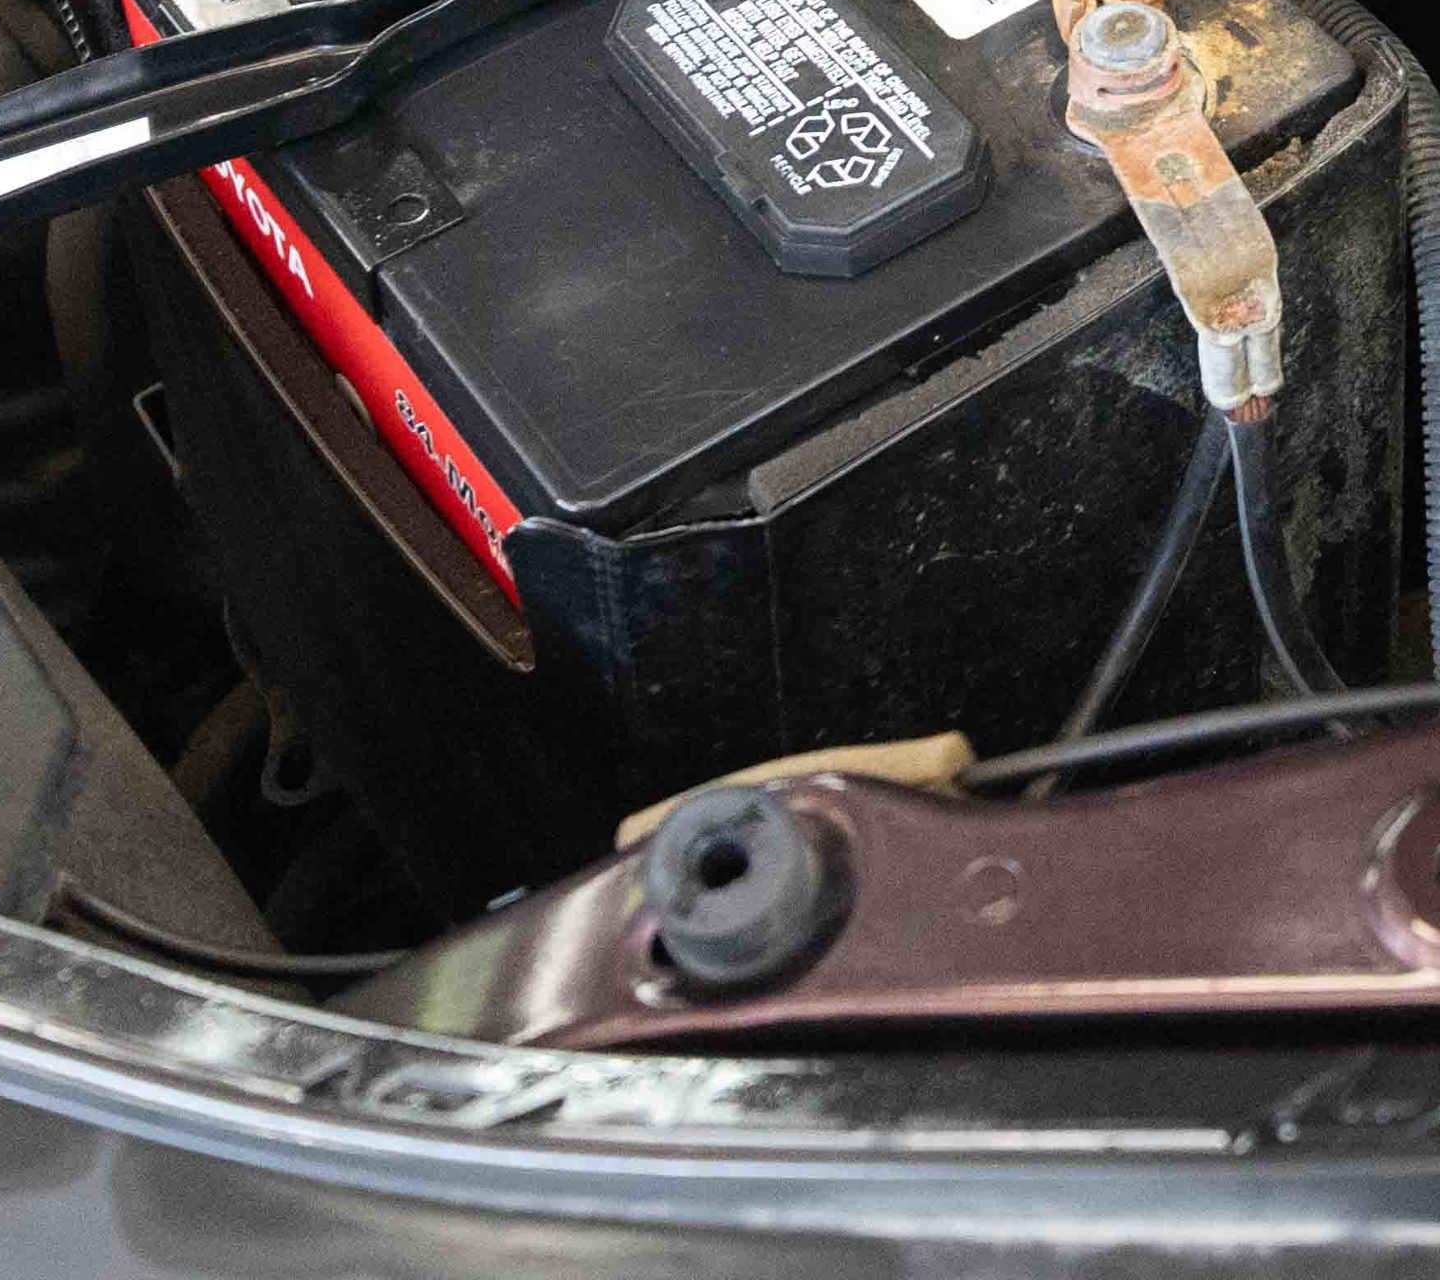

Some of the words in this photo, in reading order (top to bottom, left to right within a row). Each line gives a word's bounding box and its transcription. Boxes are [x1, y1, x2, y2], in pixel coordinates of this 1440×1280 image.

[747, 38, 782, 61] HELP
[778, 46, 807, 69] GET
[902, 111, 932, 141] LEVEL
[770, 154, 812, 195] RECYCLE
